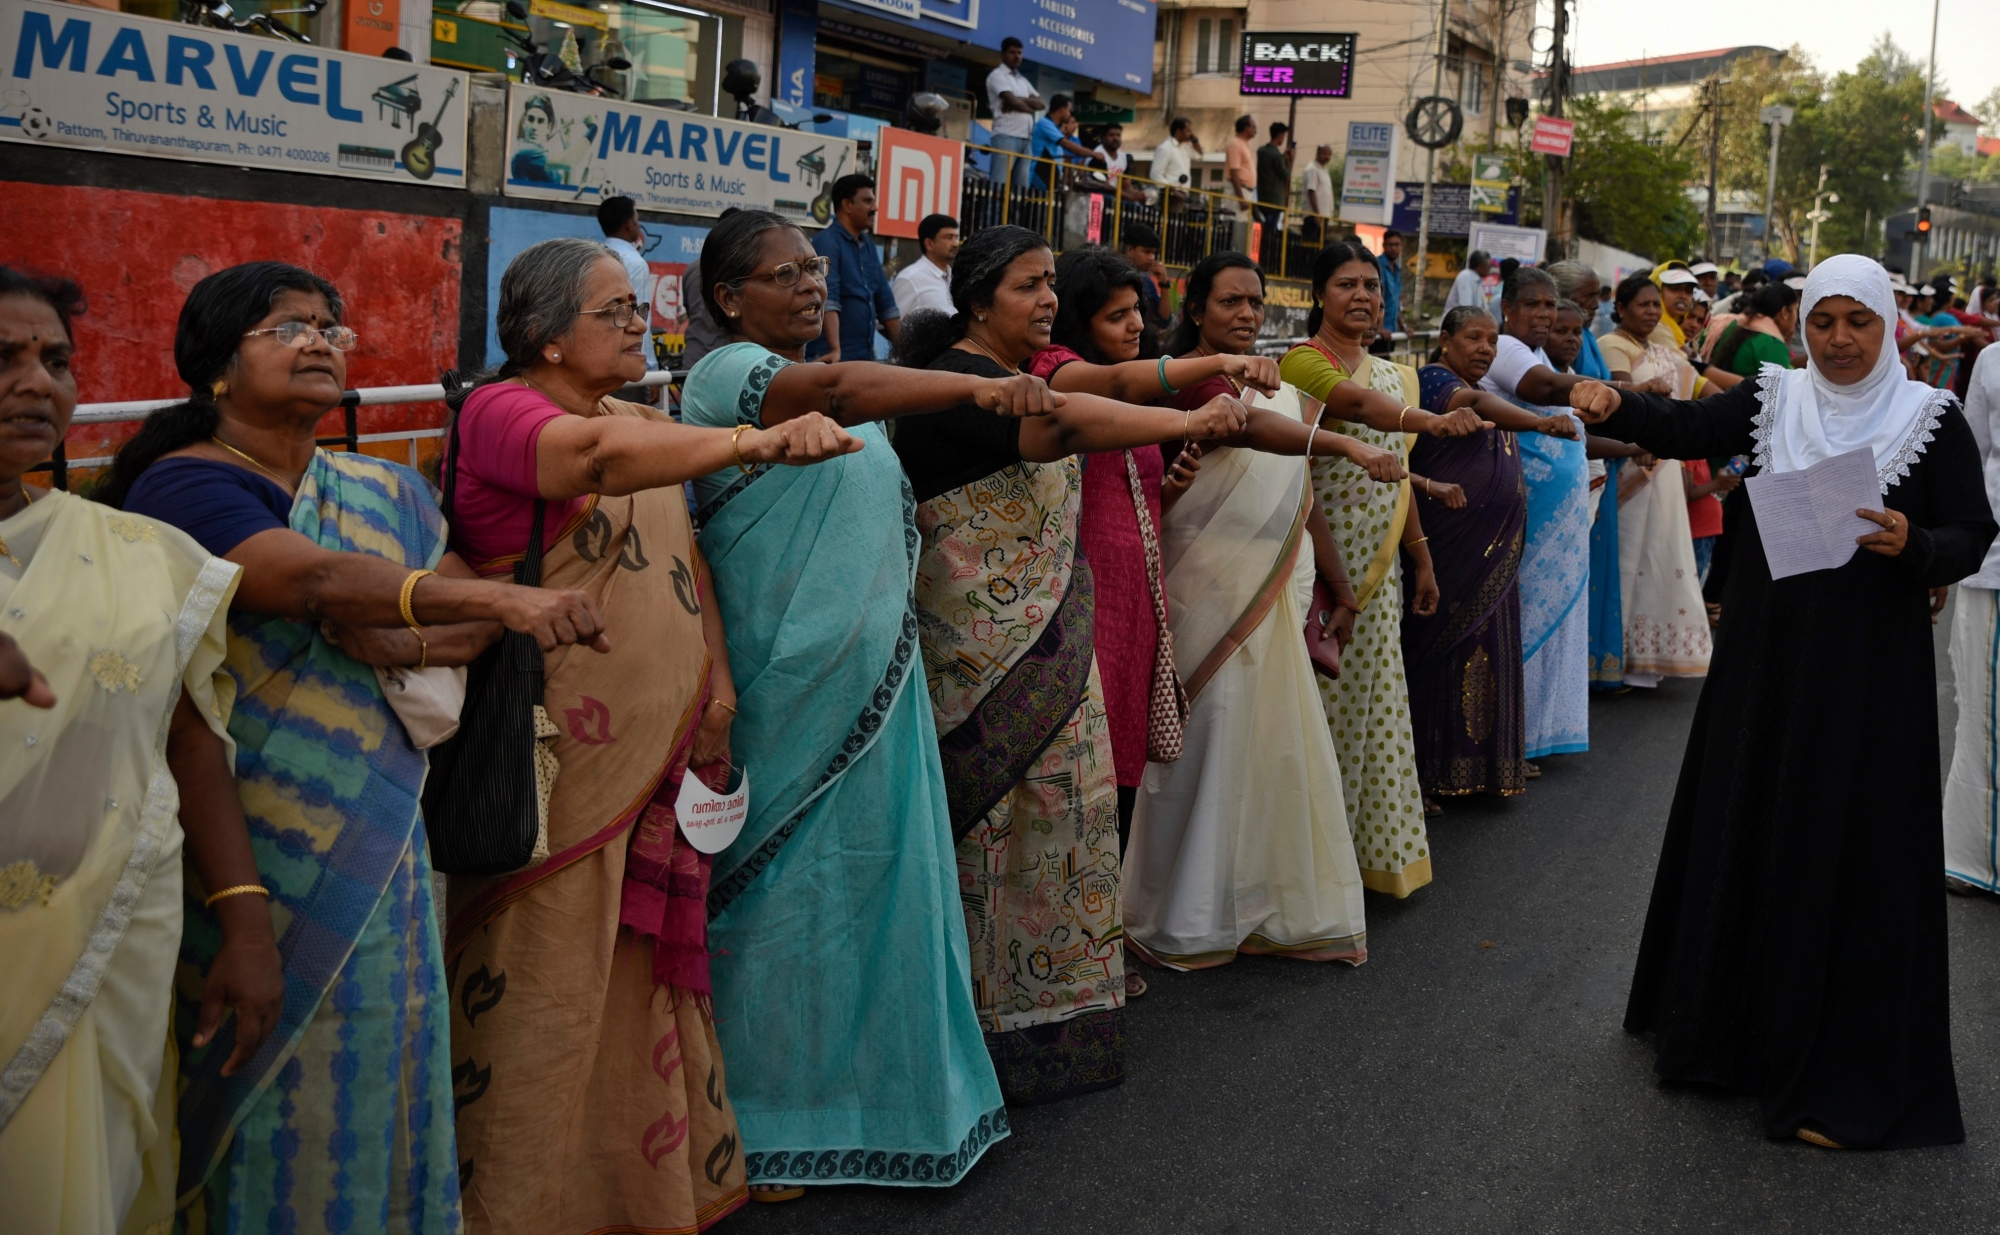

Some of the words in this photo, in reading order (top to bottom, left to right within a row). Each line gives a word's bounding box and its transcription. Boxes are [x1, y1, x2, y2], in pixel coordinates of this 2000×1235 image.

[1039, 0, 1077, 19] TABLETS
[1038, 16, 1095, 45] ACCESSORIES
[1036, 35, 1083, 61] SERVICING
[1253, 42, 1343, 62] BACK
[13, 10, 363, 124] MARVEL
[106, 92, 186, 127] Sports
[197, 106, 216, 130] &
[226, 108, 288, 137] Music
[57, 121, 107, 141] Pattom,
[112, 127, 234, 156] Thiruvananthapuram,
[237, 141, 255, 156] Ph:
[257, 144, 283, 159] 0471
[285, 148, 331, 164] 4000206
[598, 111, 790, 183] MARVEL
[1352, 125, 1388, 141] ELITE
[646, 166, 689, 190] Sports
[695, 174, 706, 190] &
[710, 176, 746, 196] Music
[692, 799, 725, 814] വനിതാ
